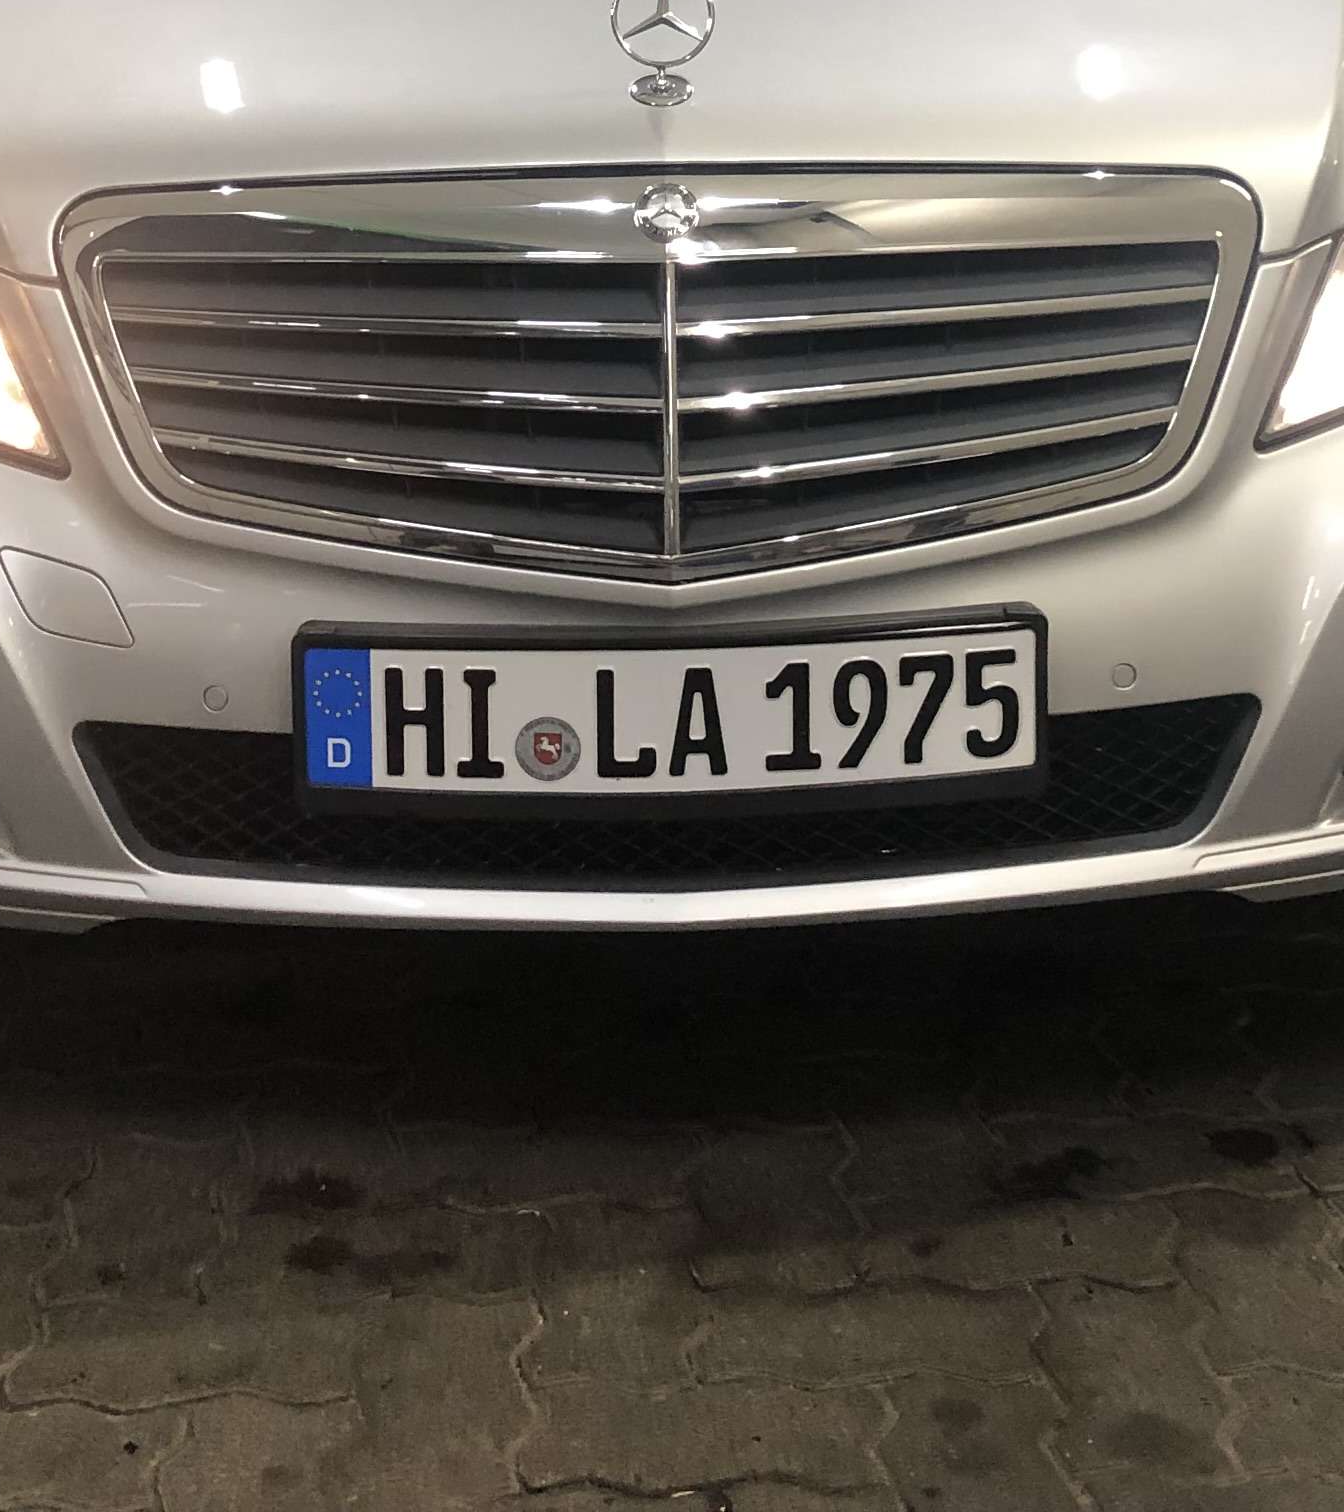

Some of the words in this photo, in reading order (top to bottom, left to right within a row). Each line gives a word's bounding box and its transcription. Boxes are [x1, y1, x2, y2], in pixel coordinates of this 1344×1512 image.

[327, 737, 351, 768] D
[384, 667, 505, 779] HI
[596, 668, 729, 779] LA
[765, 648, 1020, 772] 1975
